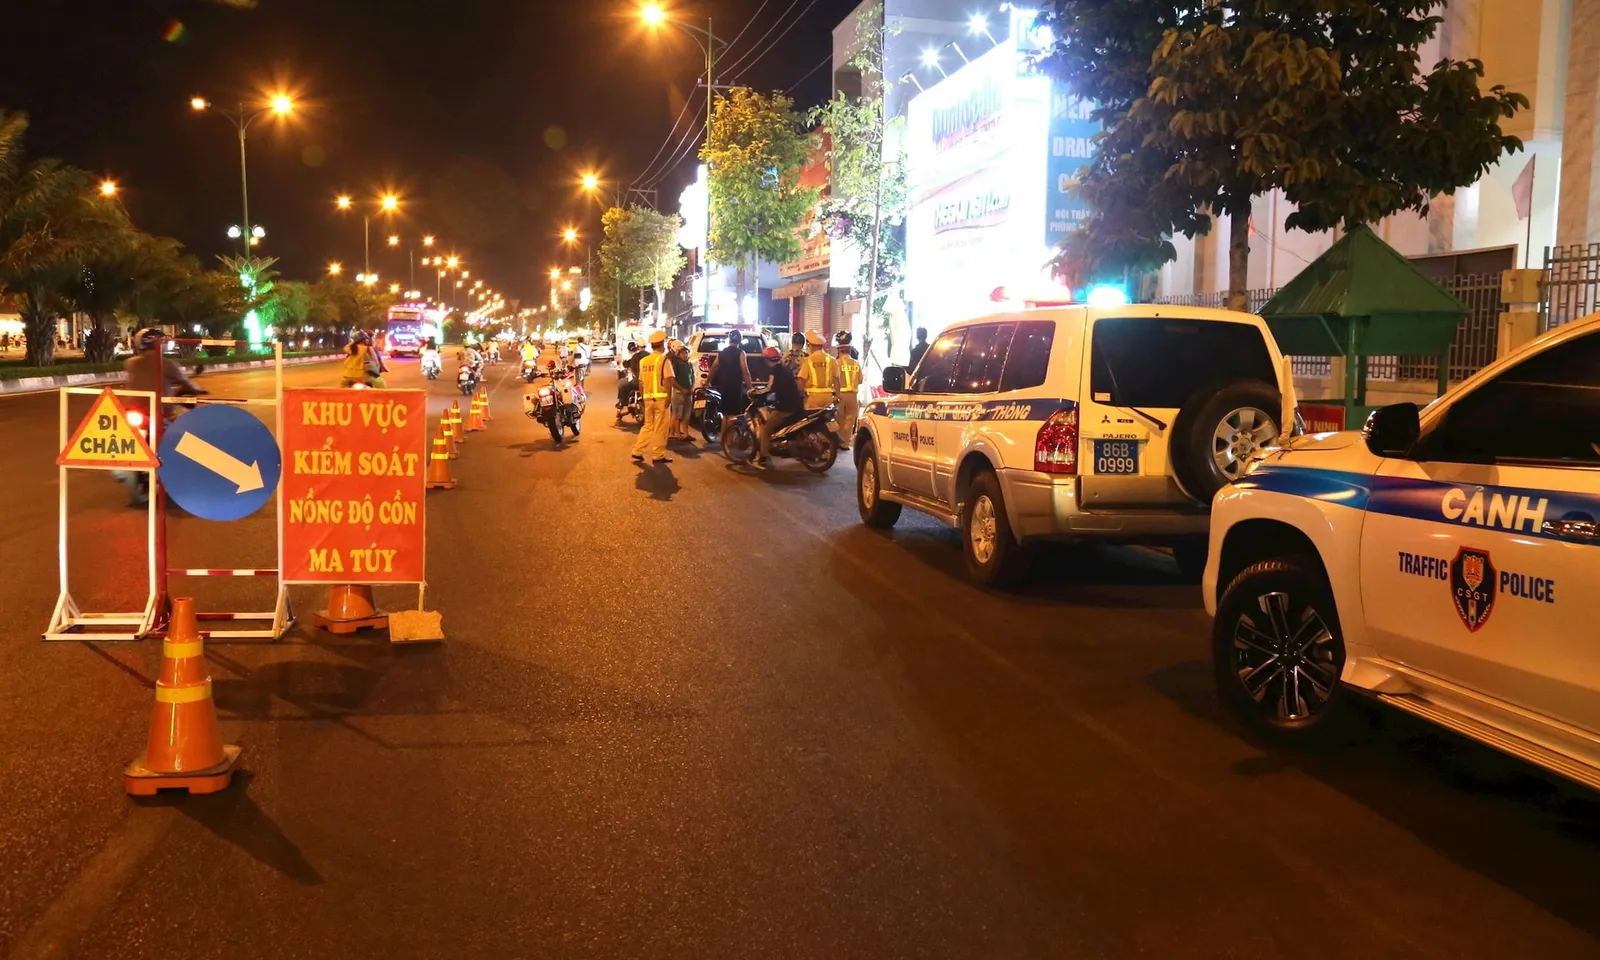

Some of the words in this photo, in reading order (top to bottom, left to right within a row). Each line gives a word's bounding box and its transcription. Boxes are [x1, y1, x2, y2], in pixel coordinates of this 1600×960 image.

[302, 401, 352, 426] KHU
[359, 400, 407, 434] VỰC
[991, 401, 1031, 420] THÔNG
[98, 415, 117, 430] ĐI
[1314, 421, 1338, 432] NINH
[80, 434, 136, 459] CHẬM
[919, 435, 935, 446] POLICE
[1103, 442, 1129, 458] 86B
[293, 436, 352, 475] KIỂM
[358, 446, 418, 476] SOÁT
[1098, 457, 1134, 473] 0999
[289, 488, 343, 524] NỒNG
[348, 494, 374, 531] ĐỘ
[379, 489, 417, 525] CỒN
[1441, 486, 1548, 534] CẢNH
[308, 549, 344, 573] MA
[350, 542, 397, 573] TÚY
[1398, 551, 1448, 581] TRAFFIC
[1500, 570, 1554, 604] POLICE
[1457, 587, 1488, 602] CSGT
